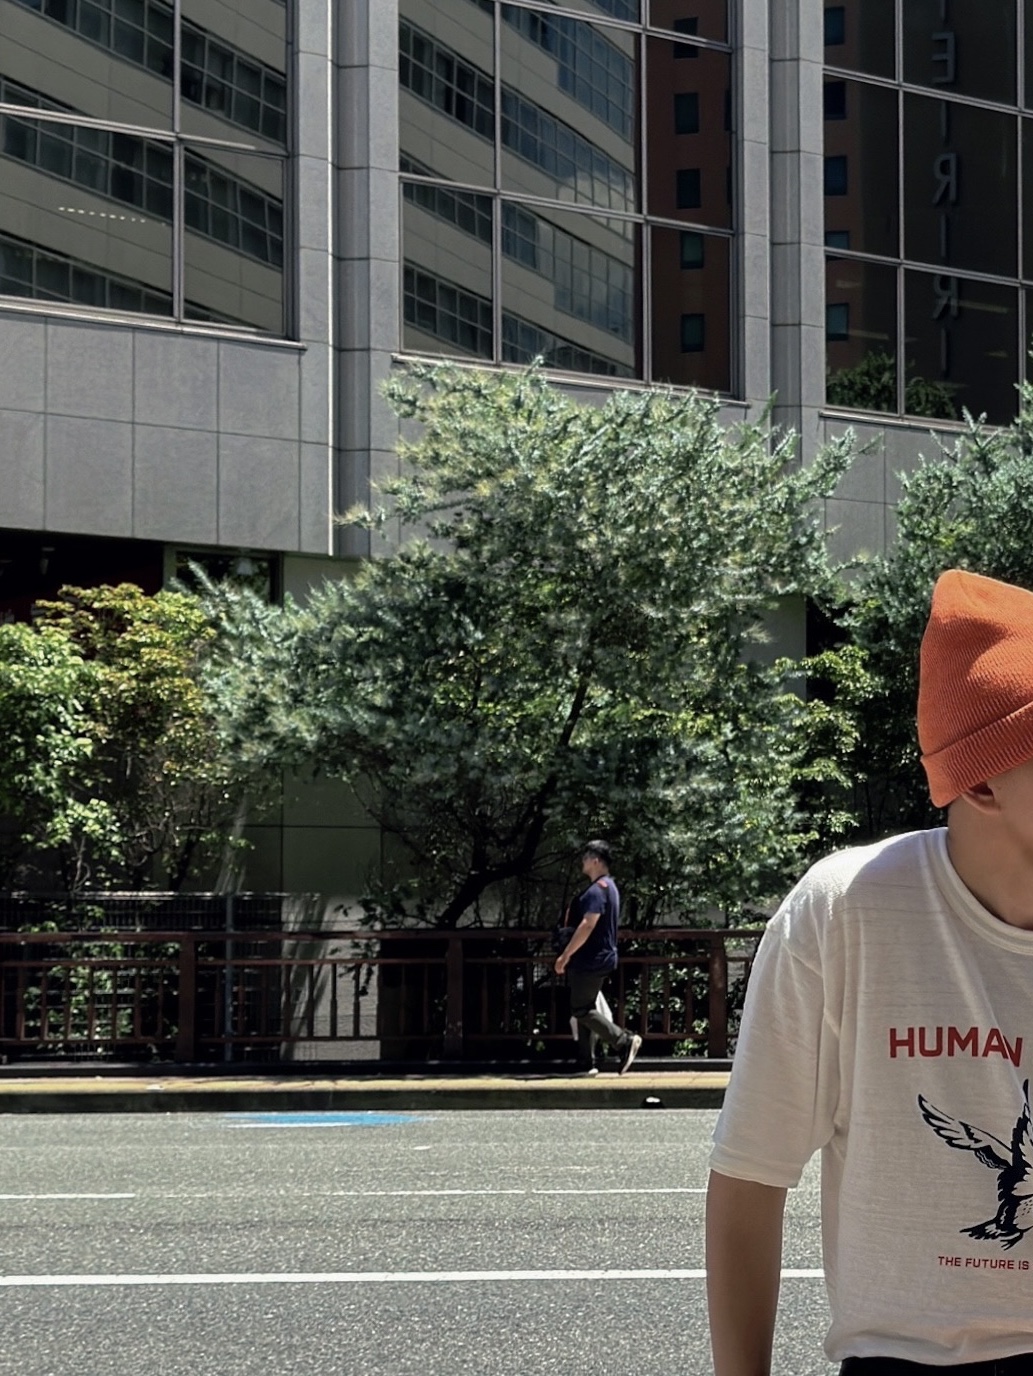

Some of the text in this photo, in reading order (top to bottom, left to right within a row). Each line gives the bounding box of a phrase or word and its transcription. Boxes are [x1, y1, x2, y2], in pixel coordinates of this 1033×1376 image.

[889, 1026, 1023, 1068] HUMAN
[938, 1256, 961, 1267] THE
[965, 1258, 1015, 1270] FUTURE
[1018, 1260, 1029, 1271] IS
